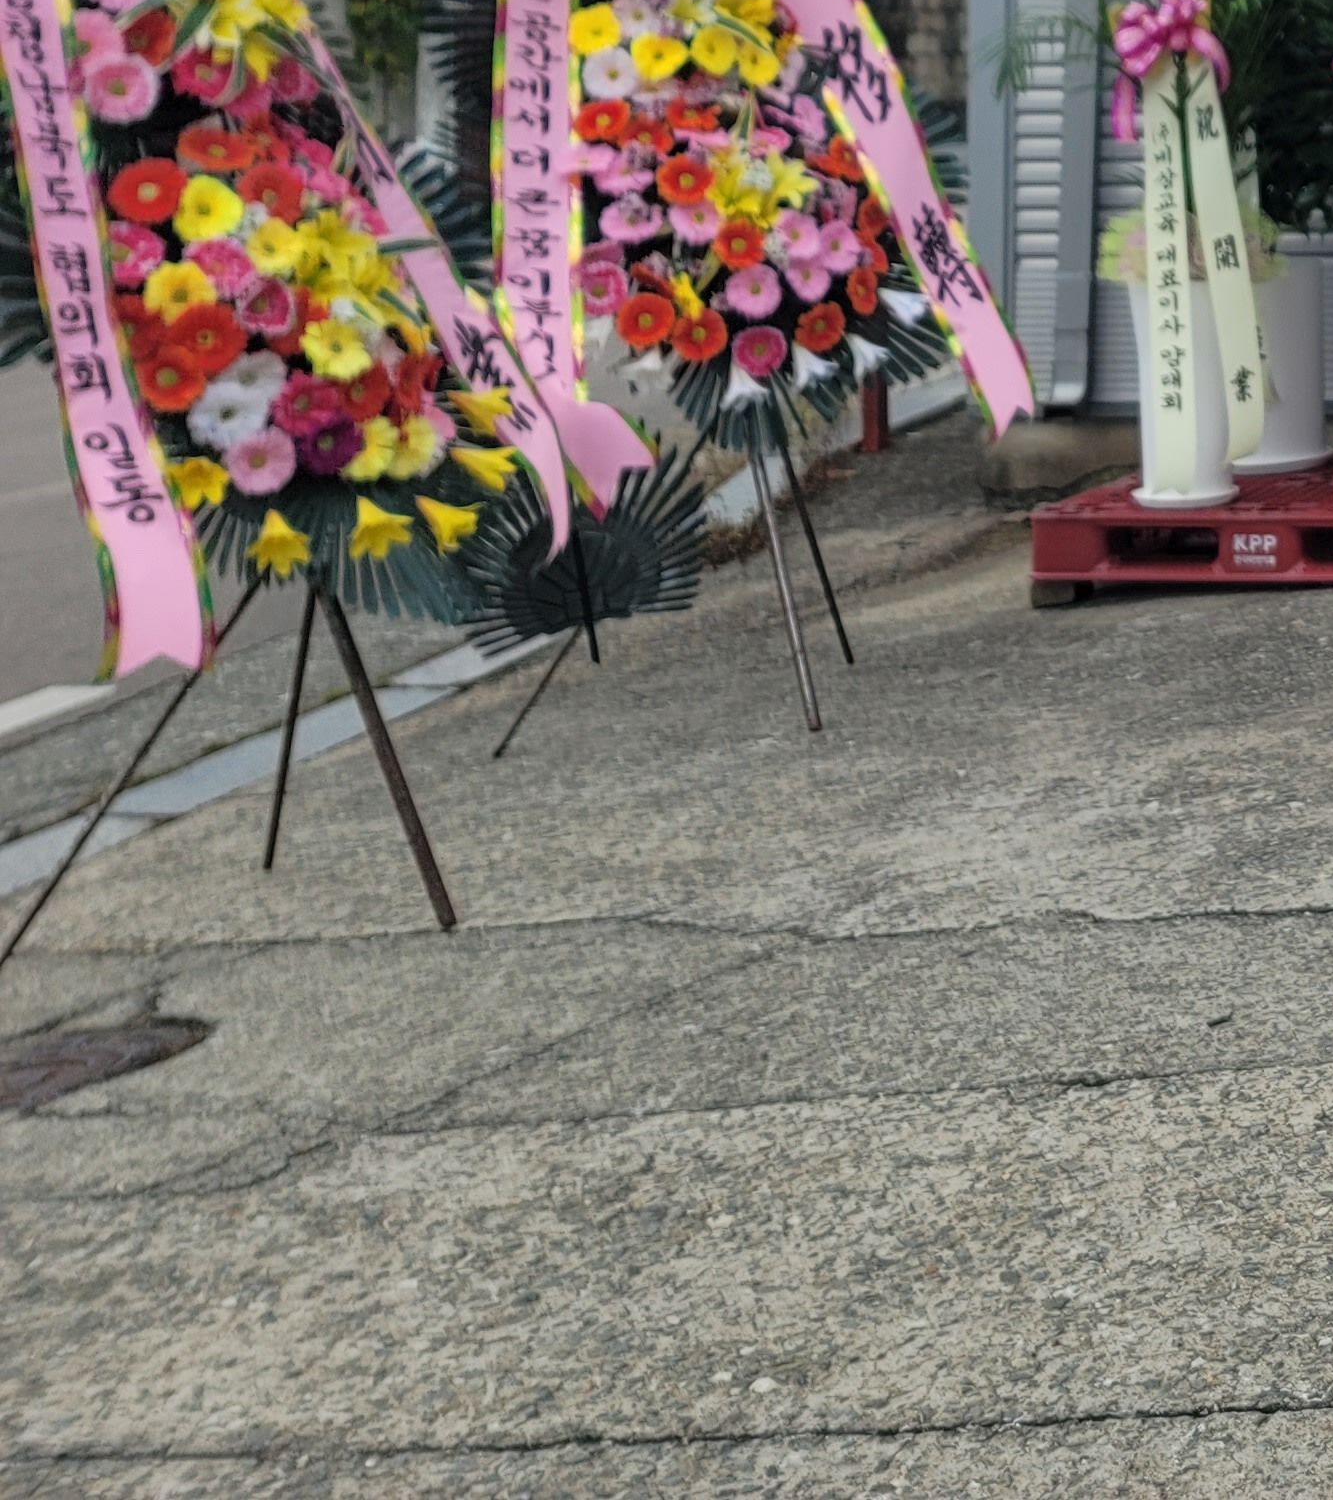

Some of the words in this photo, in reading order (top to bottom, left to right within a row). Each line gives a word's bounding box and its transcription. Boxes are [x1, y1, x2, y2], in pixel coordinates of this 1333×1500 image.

[1152, 121, 1178, 234] (주)비상교육
[1156, 244, 1185, 336] 대표이사
[1232, 533, 1277, 553] KPP
